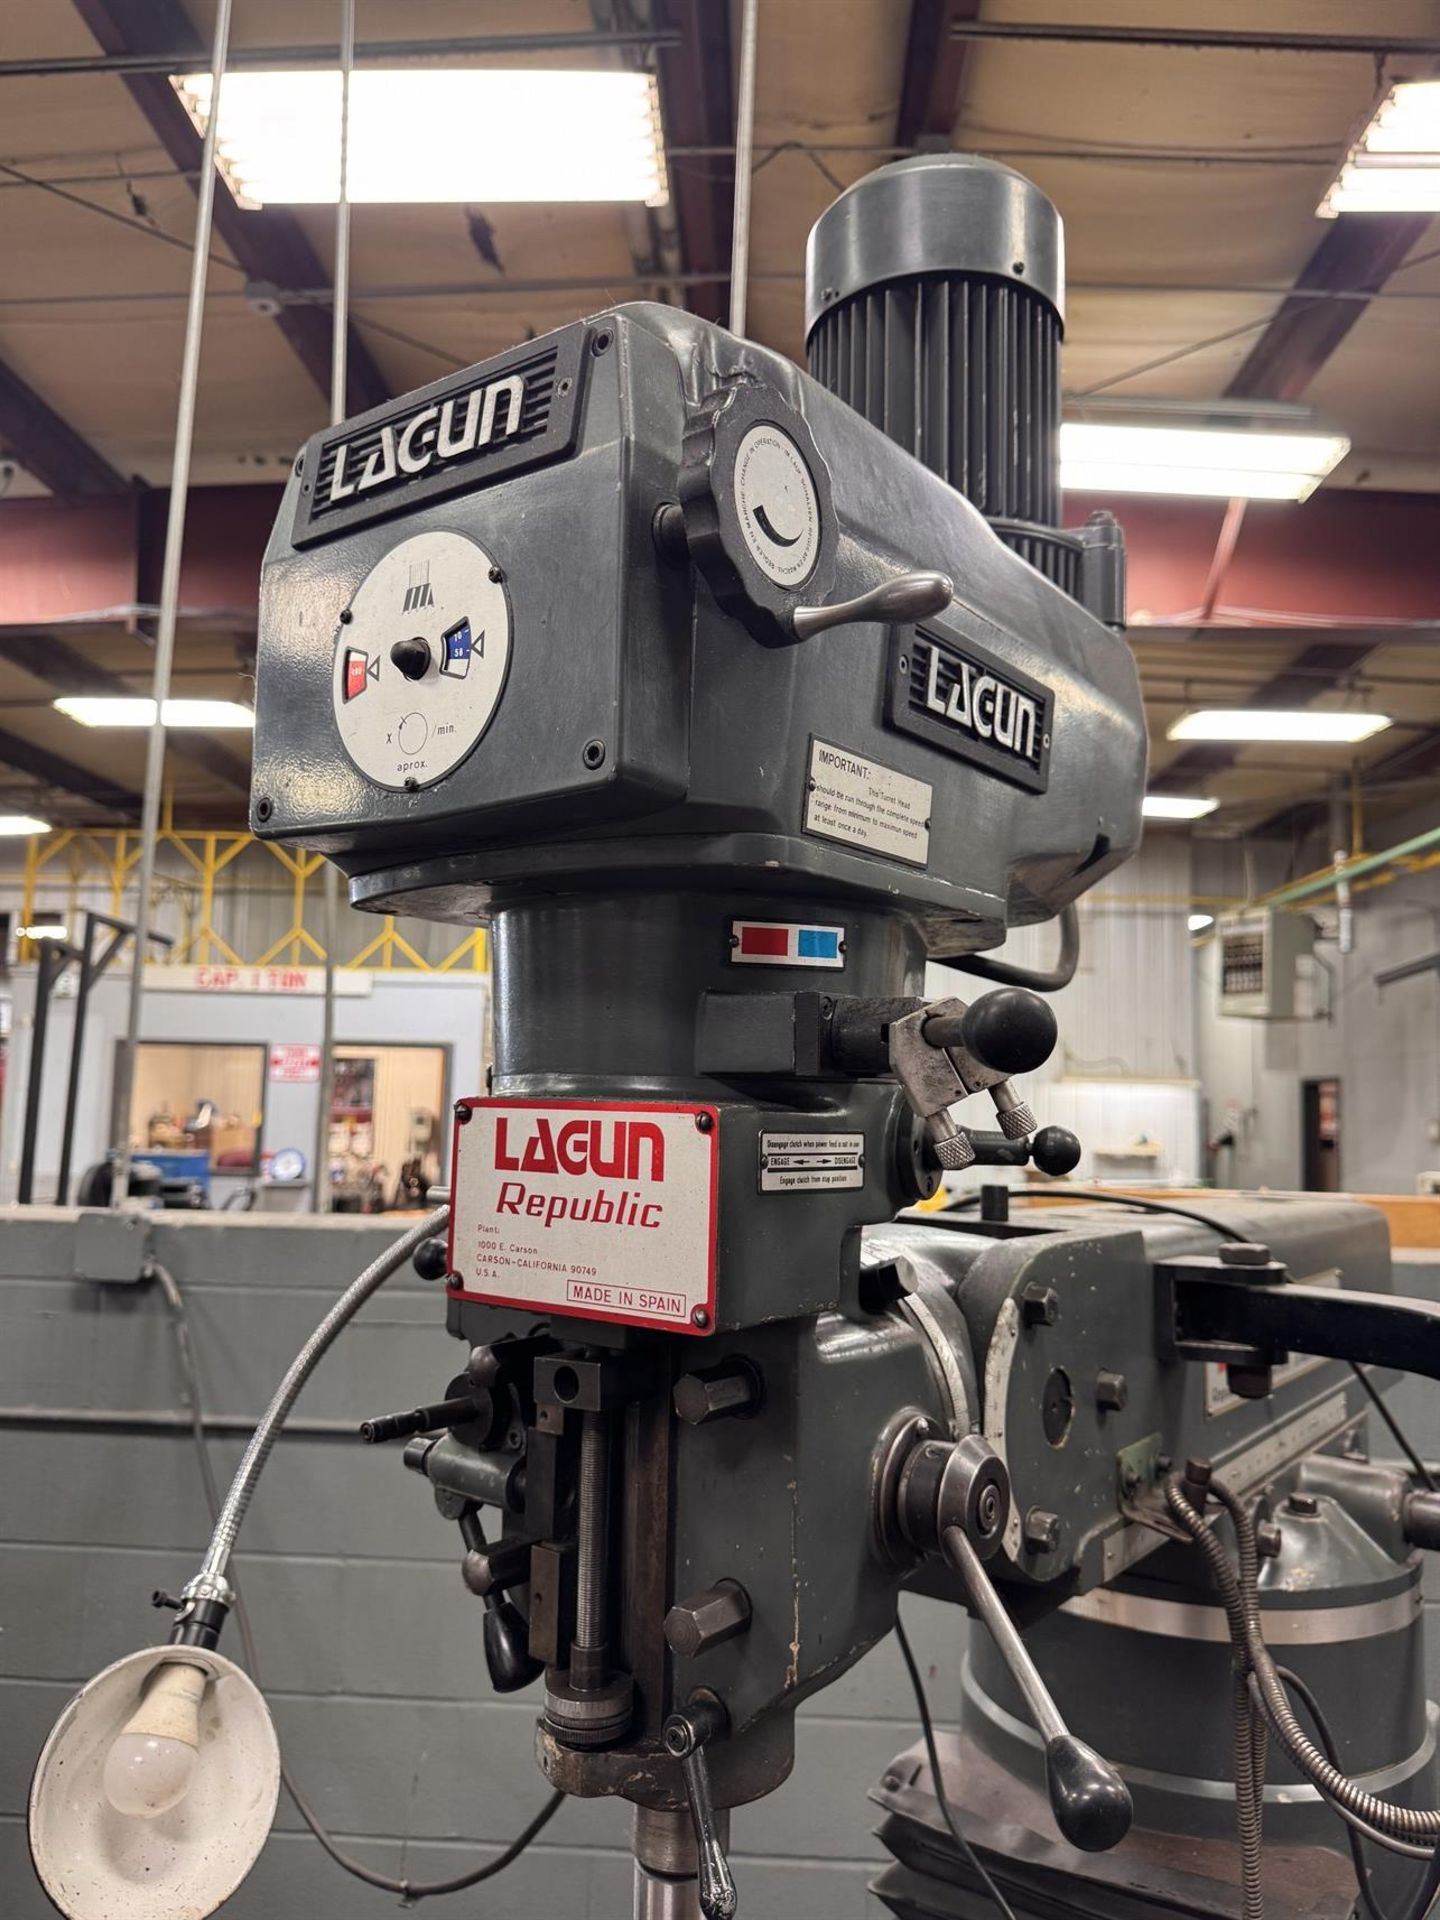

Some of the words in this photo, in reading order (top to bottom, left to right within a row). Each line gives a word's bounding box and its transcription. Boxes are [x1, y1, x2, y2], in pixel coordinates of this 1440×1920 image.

[329, 373, 527, 504] LAGUN
[926, 645, 1036, 758] LAGUN
[397, 761, 428, 774] aprox.
[818, 749, 872, 780] IMPORTANT:
[816, 784, 836, 797] should
[836, 790, 844, 800] be
[845, 795, 854, 804] run
[855, 797, 876, 812] through
[876, 804, 885, 815] the
[886, 808, 909, 824] complete
[910, 817, 925, 828] speed
[897, 799, 911, 810] Head
[814, 814, 820, 823] at
[822, 815, 836, 827] least
[837, 822, 852, 833] once
[815, 799, 832, 812] range
[833, 804, 847, 816] from
[848, 810, 871, 823] minimum
[872, 817, 878, 826] to
[902, 828, 918, 839] speed
[494, 1117, 665, 1182] LAGUN
[803, 1139, 815, 1148] when
[770, 1157, 790, 1166] ENGAGE
[779, 1175, 796, 1186] Engage
[797, 1175, 810, 1184] clutch
[811, 1175, 821, 1183] from
[496, 1182, 663, 1228] Republic
[477, 1240, 497, 1251] 1000
[499, 1242, 507, 1252] E.
[509, 1243, 538, 1255] Carson
[476, 1253, 567, 1273] CARSON-CALIFORNIA
[570, 1265, 597, 1277] 90749
[573, 1285, 612, 1304] MADE
[618, 1290, 633, 1306] IN
[639, 1293, 683, 1314] SPAIN
